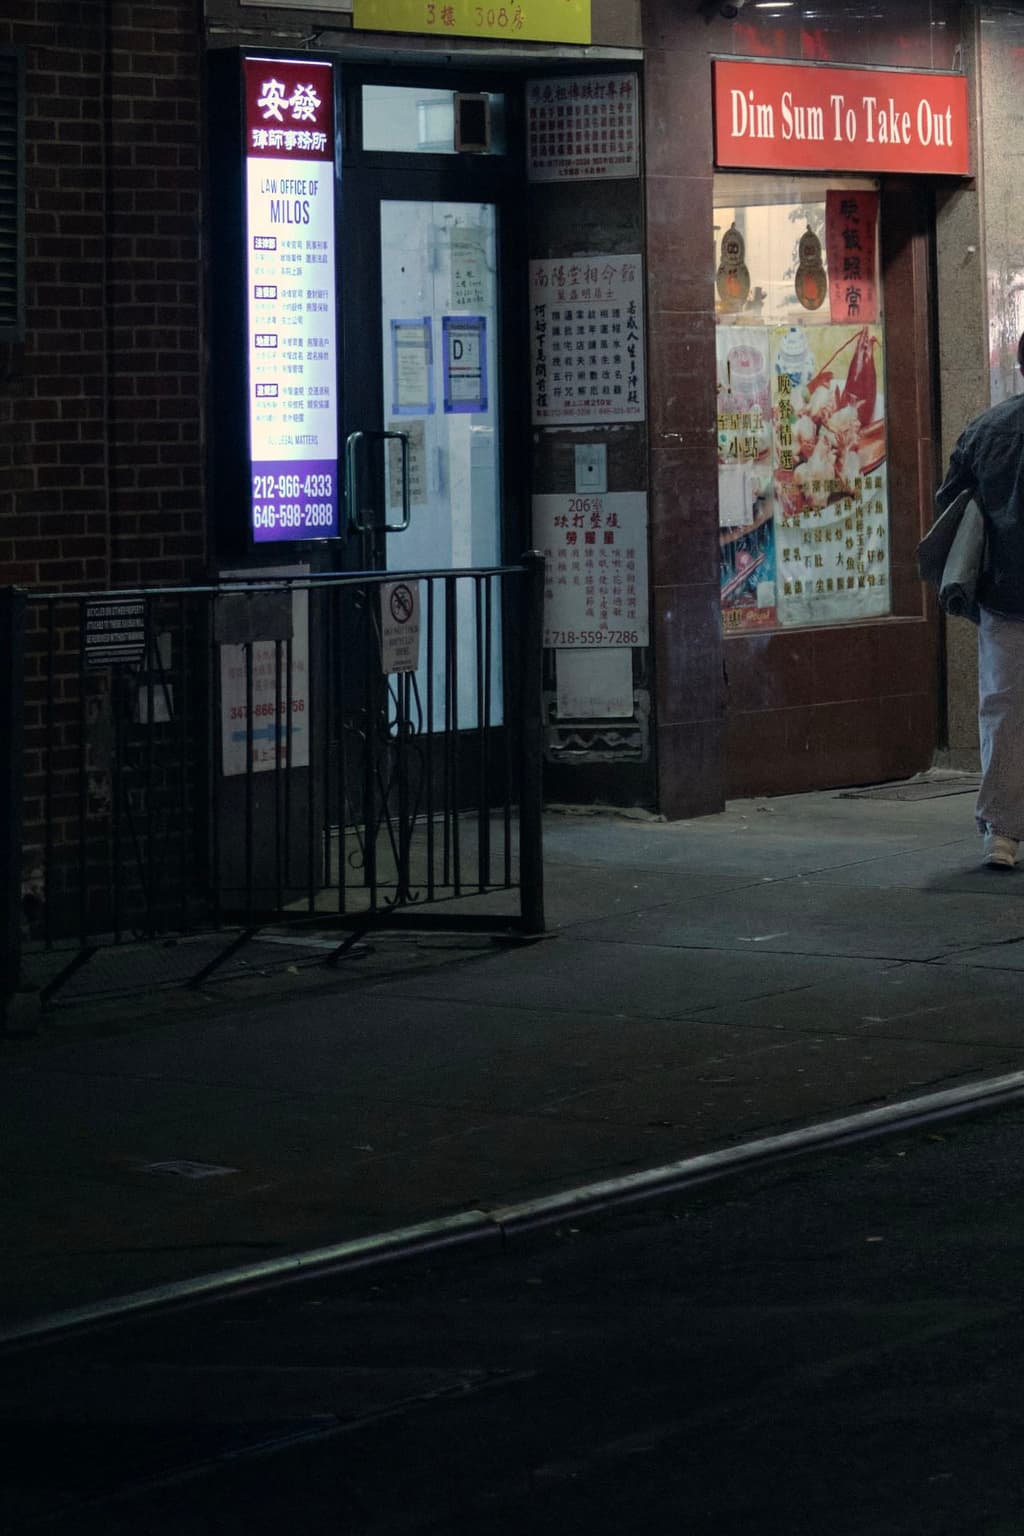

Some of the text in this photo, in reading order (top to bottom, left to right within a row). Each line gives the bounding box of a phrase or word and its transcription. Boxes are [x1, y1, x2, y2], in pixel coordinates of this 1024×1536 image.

[257, 78, 322, 122] 安發
[730, 89, 953, 147] Dim Sum To Take Out
[252, 128, 327, 153] 律師事務所
[261, 178, 319, 196] LAW OFFICE OF
[270, 200, 310, 225] MILOS
[253, 474, 332, 499] 212-966-4333
[253, 502, 332, 529] 646-598-2888
[552, 631, 639, 645] 718-559-7286
